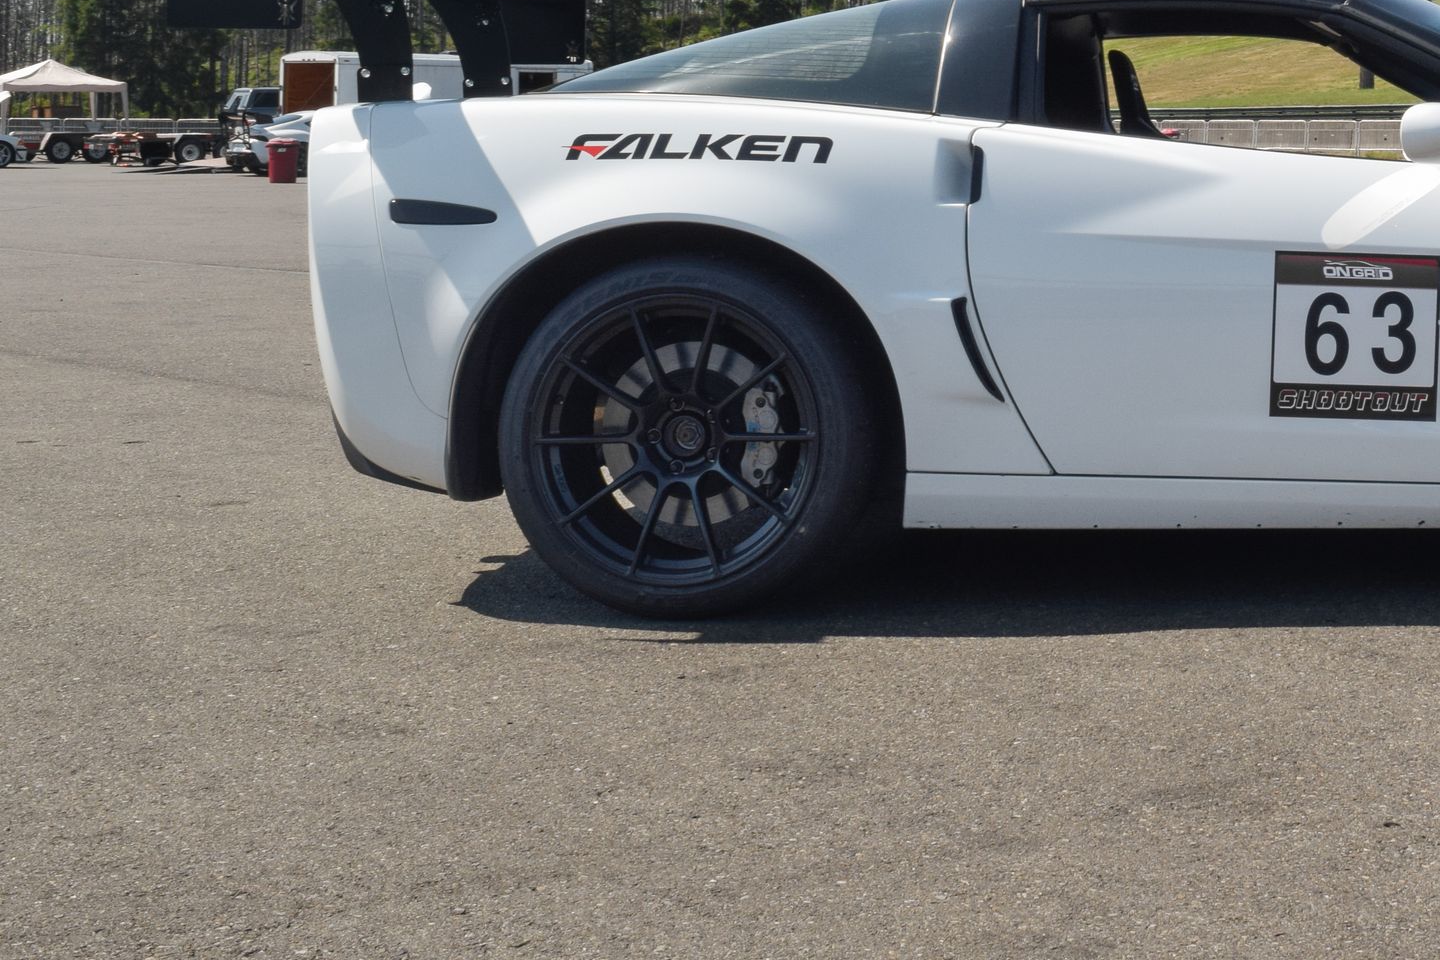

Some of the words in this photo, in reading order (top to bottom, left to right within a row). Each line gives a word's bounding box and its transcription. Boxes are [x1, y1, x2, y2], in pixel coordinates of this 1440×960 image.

[561, 133, 834, 164] FALKEN
[1305, 291, 1416, 376] 63
[1277, 389, 1429, 413] SHOOTOUT
